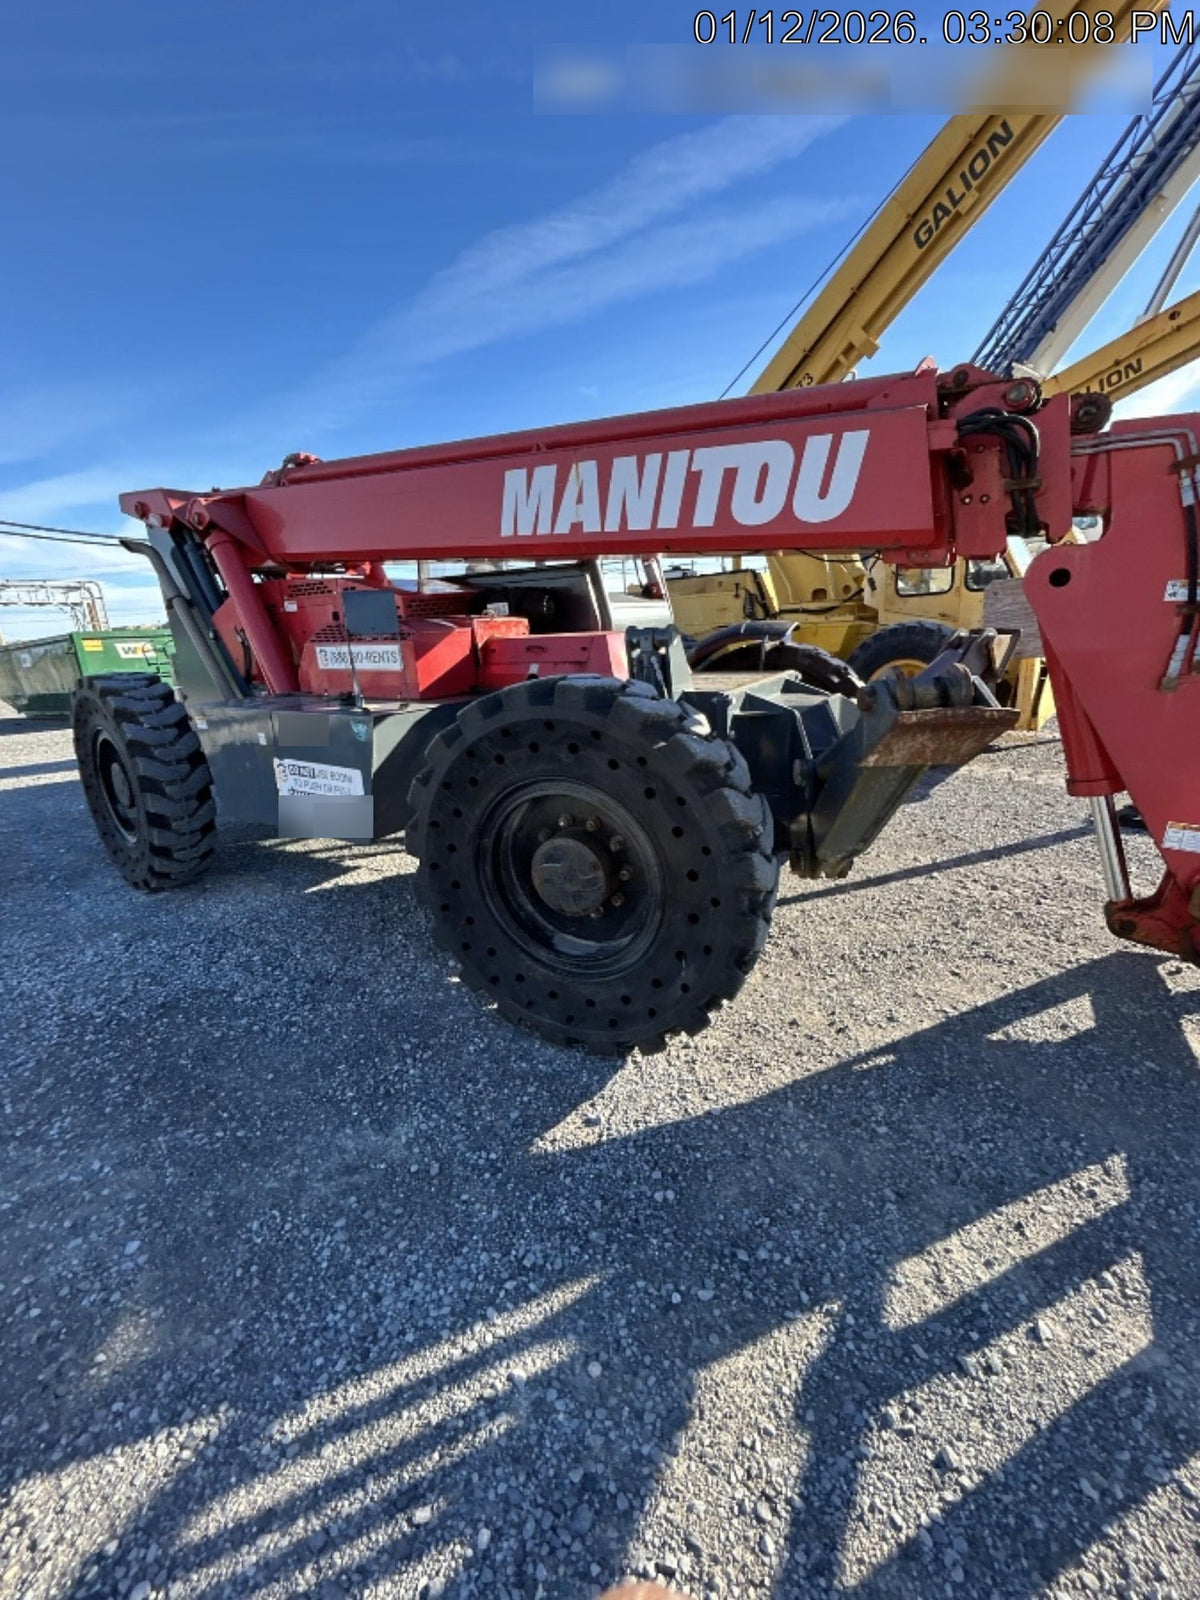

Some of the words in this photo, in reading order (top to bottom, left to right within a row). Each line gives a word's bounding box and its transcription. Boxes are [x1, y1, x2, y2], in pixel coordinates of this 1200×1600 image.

[913, 119, 1015, 250] GALION
[1077, 356, 1143, 394] LION
[500, 429, 870, 537] MANITOU
